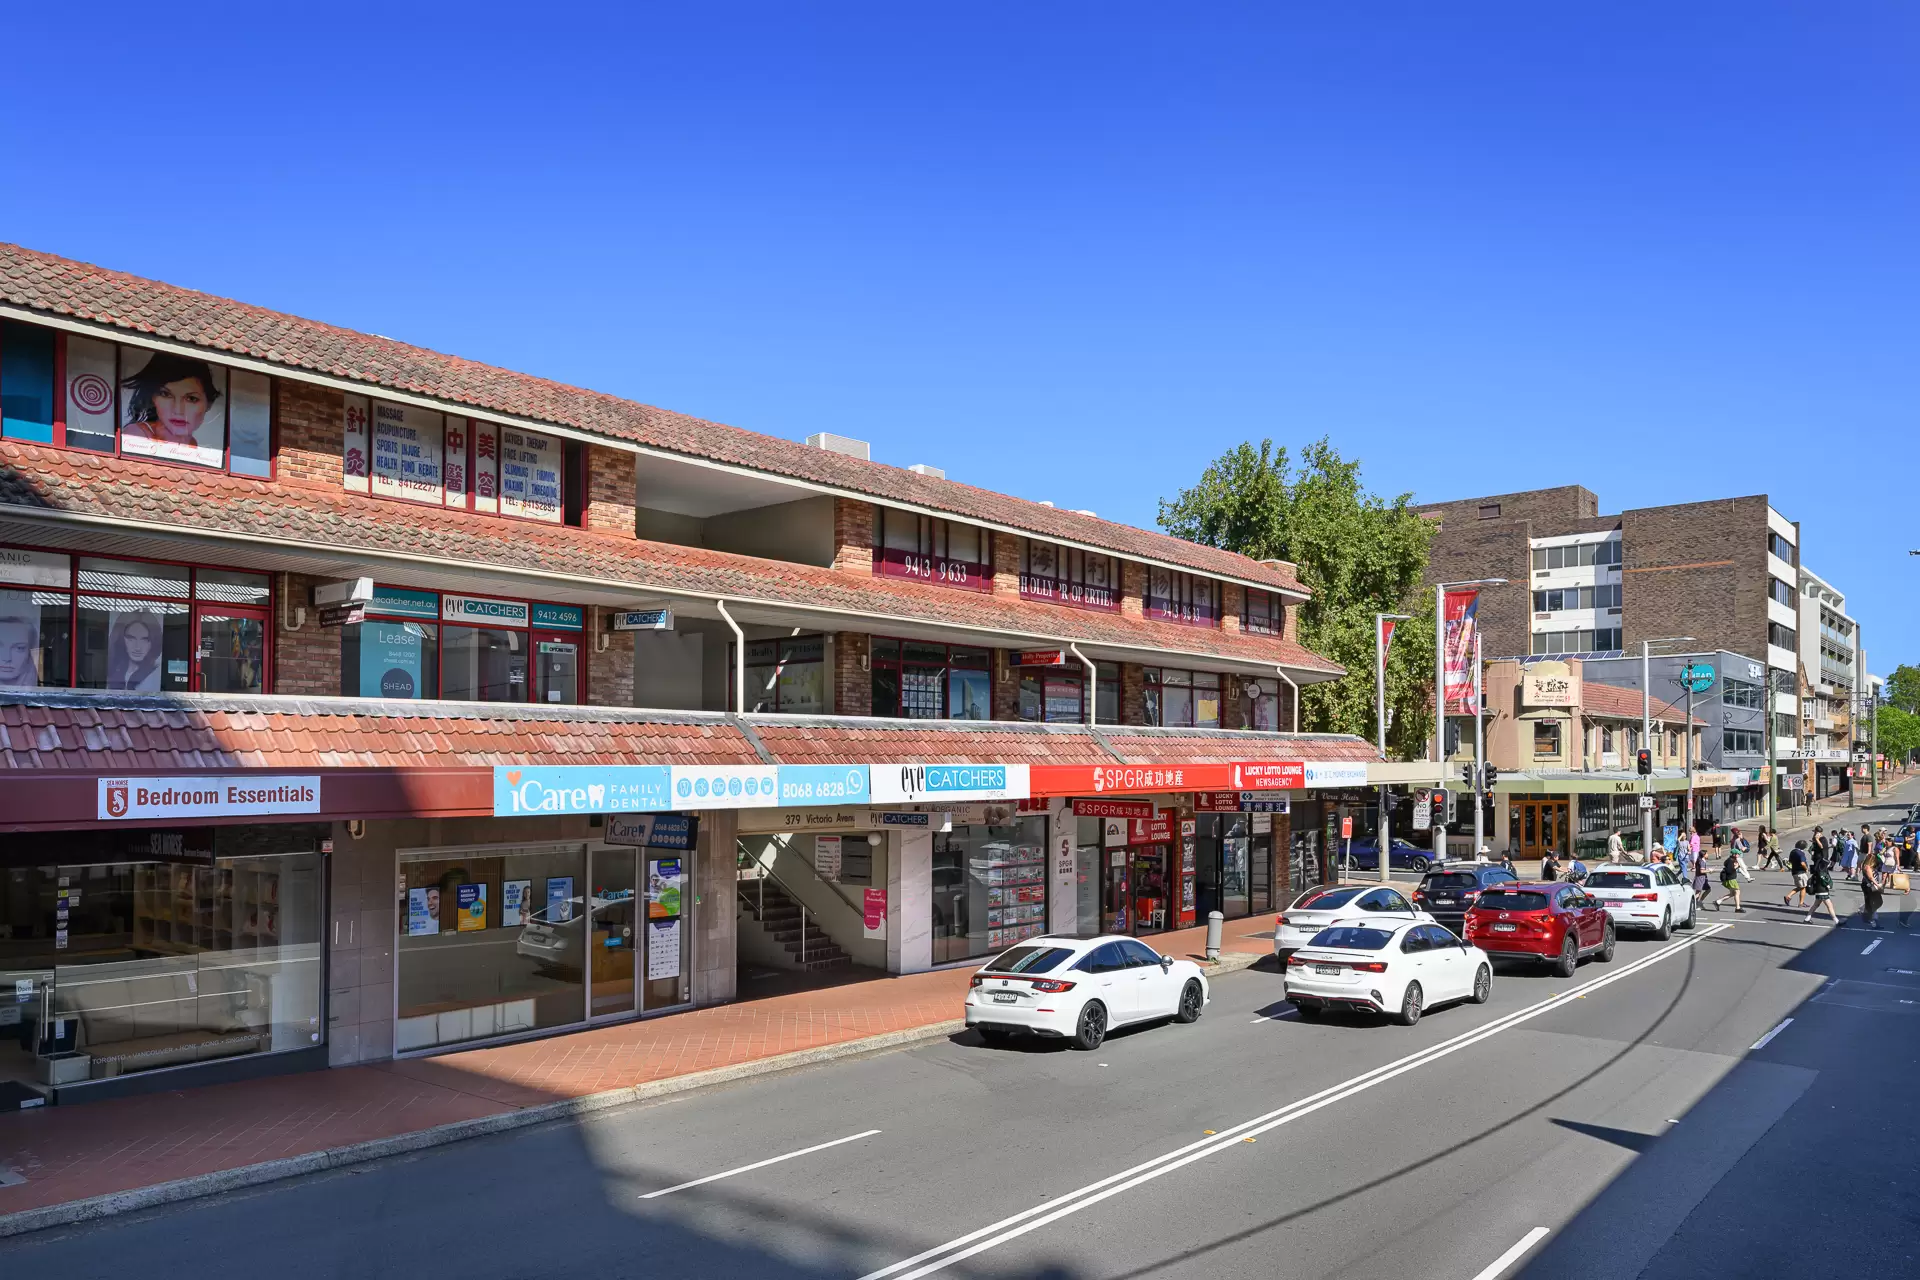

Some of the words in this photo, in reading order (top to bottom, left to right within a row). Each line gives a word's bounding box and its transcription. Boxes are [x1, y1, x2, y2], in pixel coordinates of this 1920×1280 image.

[377, 406, 404, 422] MASSAGE
[376, 421, 416, 440] ACUPUNCTURE
[376, 439, 398, 454] SPORTS
[401, 444, 421, 458] INJURE
[504, 432, 523, 445] OXYGEN
[526, 436, 548, 451] THERAPY
[504, 448, 516, 461] FACE
[519, 451, 538, 464] LIFTING
[376, 456, 398, 470] HEALTH
[401, 459, 415, 473] FUND
[418, 463, 438, 478] REBATE
[478, 432, 495, 497] 美容
[377, 474, 393, 486] TEL:
[504, 463, 529, 478] SLIMMING
[536, 469, 556, 483] FIRMING
[503, 478, 524, 493] WAXING
[504, 495, 518, 507] TEL:
[905, 555, 931, 578] 9413
[940, 562, 967, 583] 9633
[1020, 575, 1054, 597] HOLLY
[366, 595, 436, 609] yecatcher.net.au
[445, 597, 463, 617] eye
[465, 601, 525, 618] CATCHERS
[537, 610, 557, 621] 9412
[559, 612, 577, 622] 4596
[627, 612, 665, 624] CATCHERS
[1162, 602, 1179, 619] 943
[379, 630, 415, 646] Lease
[383, 682, 412, 691] SHEAD
[1790, 750, 1816, 758] 71-73
[1245, 766, 1264, 776] LUCKY
[1264, 766, 1280, 775] LOTTO
[1281, 765, 1303, 775] LOUNGE
[901, 765, 924, 800] eye
[928, 769, 1004, 788] CATCHERS
[1106, 769, 1144, 789] SPGR
[1255, 777, 1293, 787] NEWSAGENCY
[1615, 782, 1634, 792] KAI
[136, 787, 219, 806] Bedroom
[227, 785, 314, 804] Essentials
[509, 778, 587, 812] iCare
[610, 784, 662, 795] FAMILY
[782, 782, 812, 799] 8068
[815, 780, 845, 797] 6828
[610, 797, 666, 809] DENTAL
[1086, 804, 1116, 815] SPGR
[785, 814, 800, 825] 379
[806, 813, 833, 824] Victoria
[836, 812, 855, 822] Avenu
[870, 812, 883, 828] eye
[885, 815, 928, 824] CATCHERS
[1154, 813, 1168, 821] CKY
[608, 819, 638, 837] iCare
[1151, 822, 1167, 831] LOTTO
[1151, 832, 1171, 841] LOUNGE
[1058, 860, 1073, 868] SPGR
[92, 1053, 126, 1066] TORONTO
[131, 1046, 174, 1059] VANCOUVER
[225, 1033, 261, 1045] SINGAPORE
